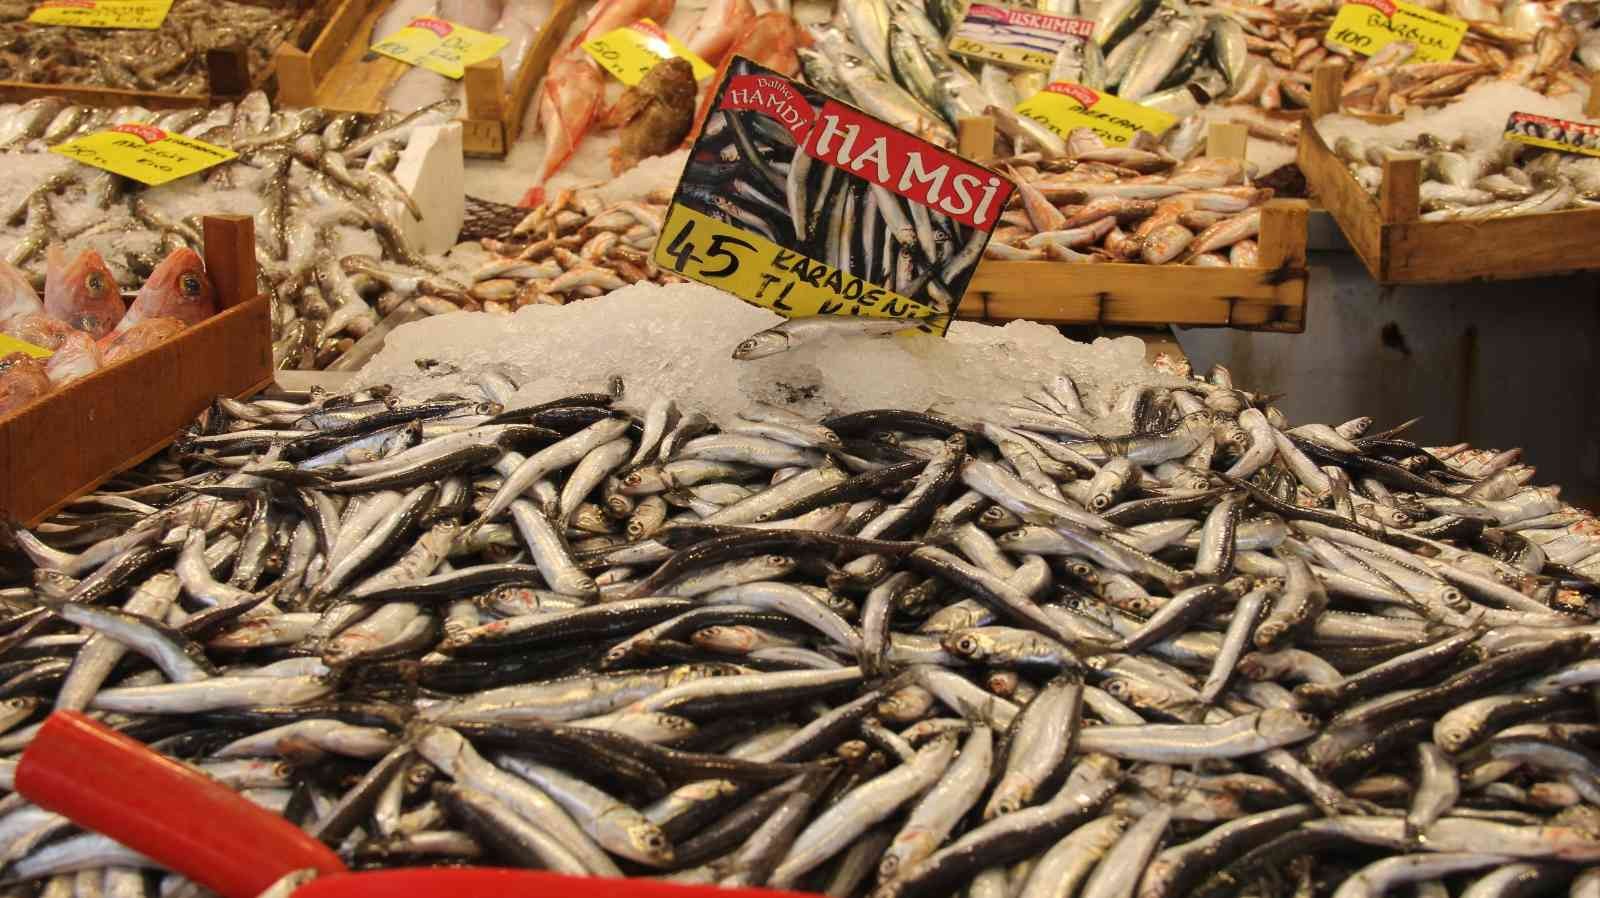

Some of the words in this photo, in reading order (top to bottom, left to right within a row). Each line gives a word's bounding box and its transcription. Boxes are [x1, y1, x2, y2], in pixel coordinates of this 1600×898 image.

[1008, 11, 1093, 36] USKUMRU
[666, 219, 759, 278] 45
[754, 272, 795, 311] TL
